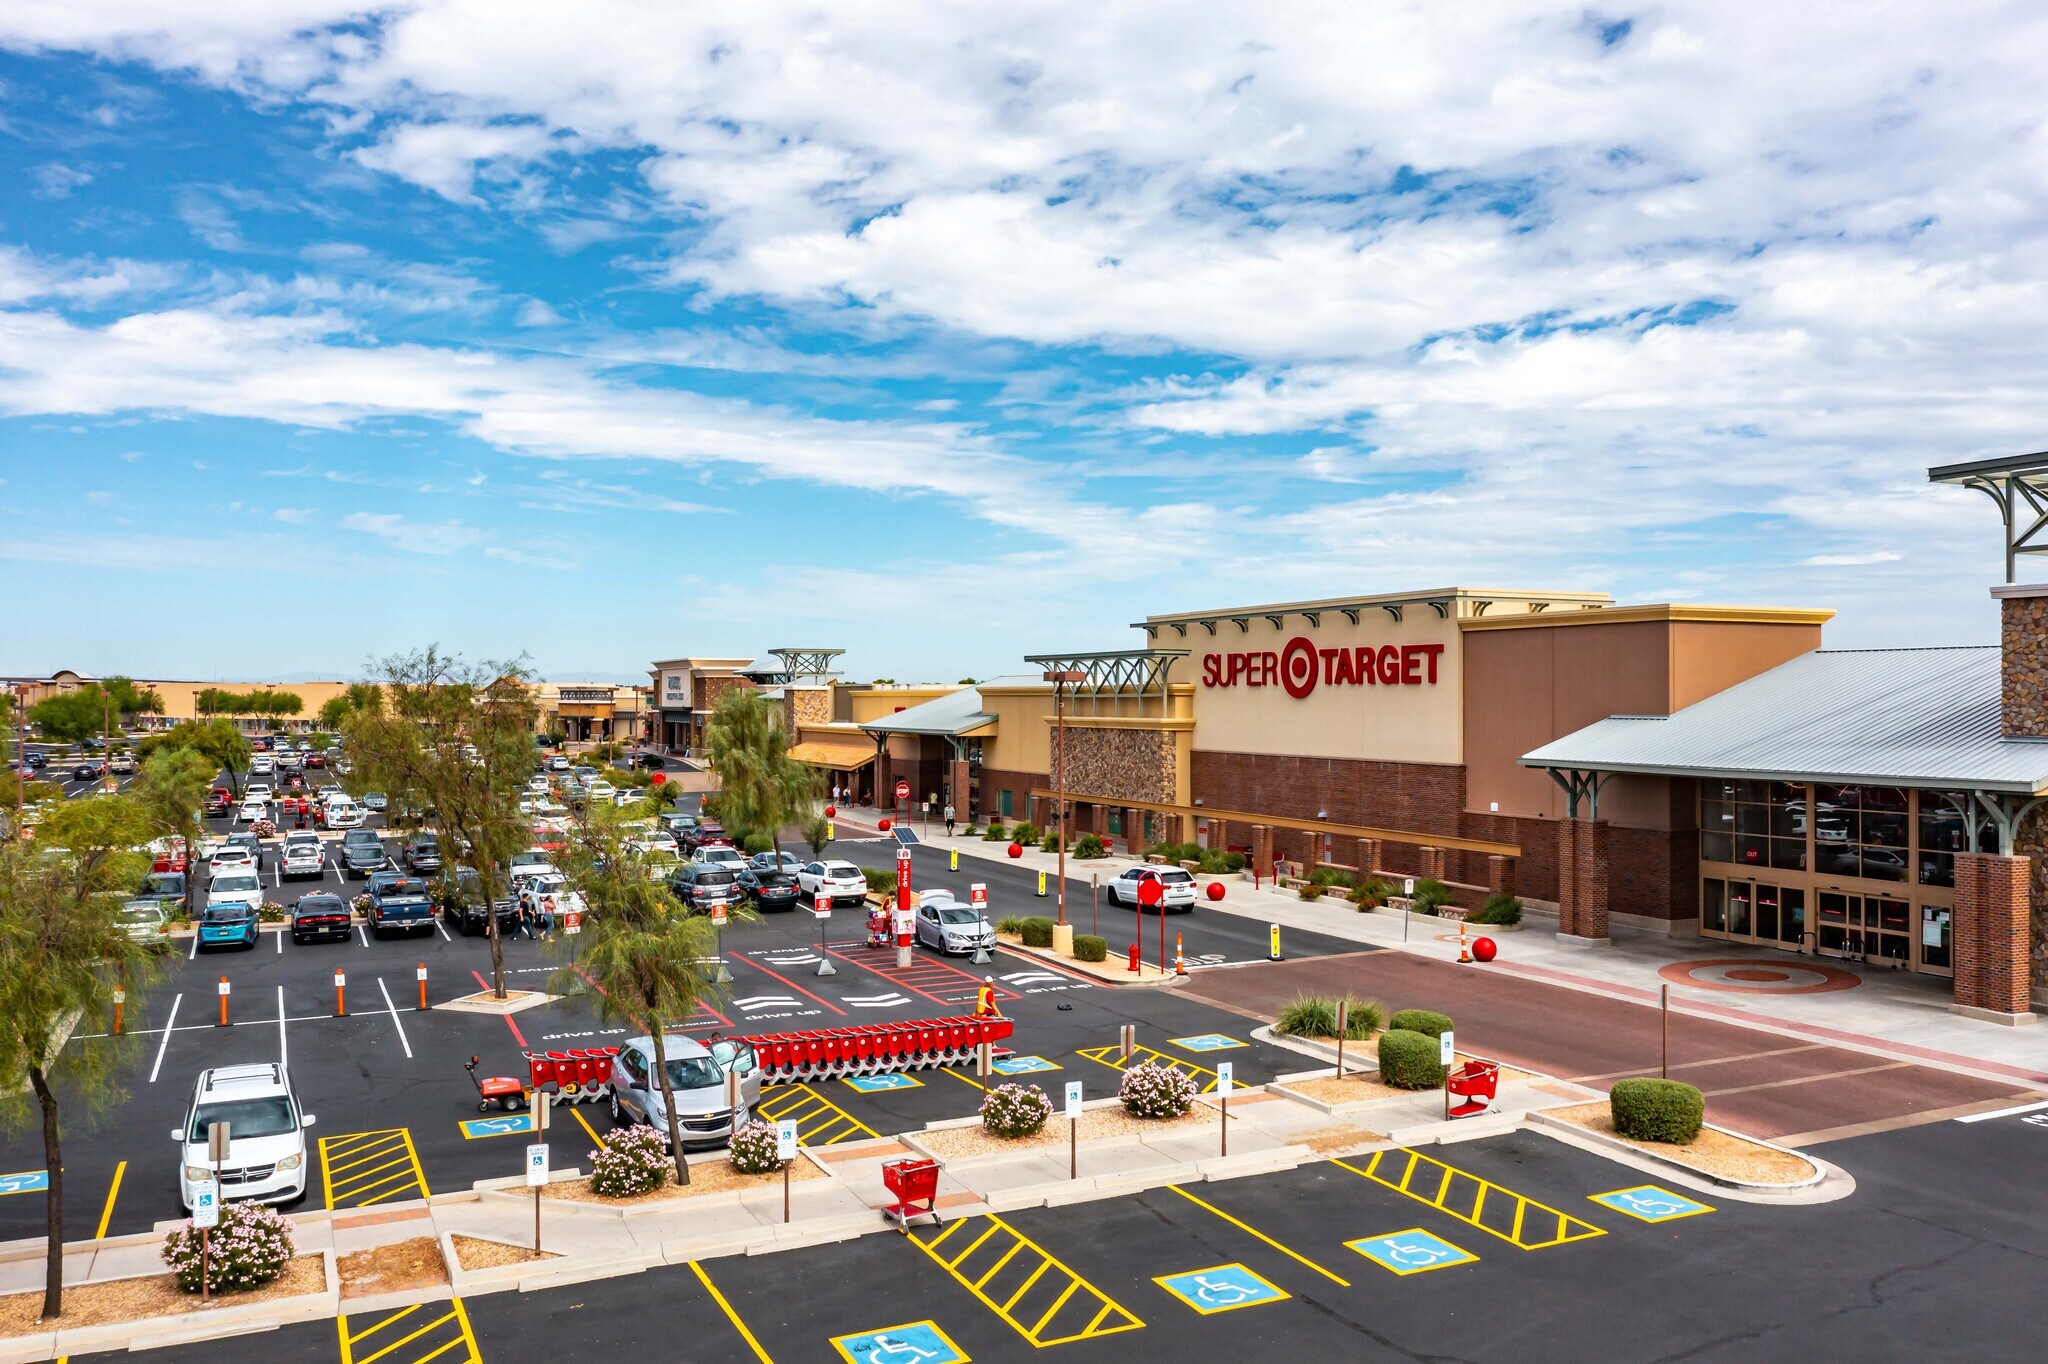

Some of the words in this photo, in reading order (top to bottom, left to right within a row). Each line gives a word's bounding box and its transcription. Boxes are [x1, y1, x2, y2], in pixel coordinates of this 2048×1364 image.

[1203, 651, 1278, 687] SUPER
[1318, 644, 1444, 685] TARGET
[903, 860, 909, 869] up
[1025, 985, 1067, 994] drive
[744, 1012, 793, 1021] drive
[542, 1031, 594, 1040] drive
[599, 1028, 626, 1036] up
